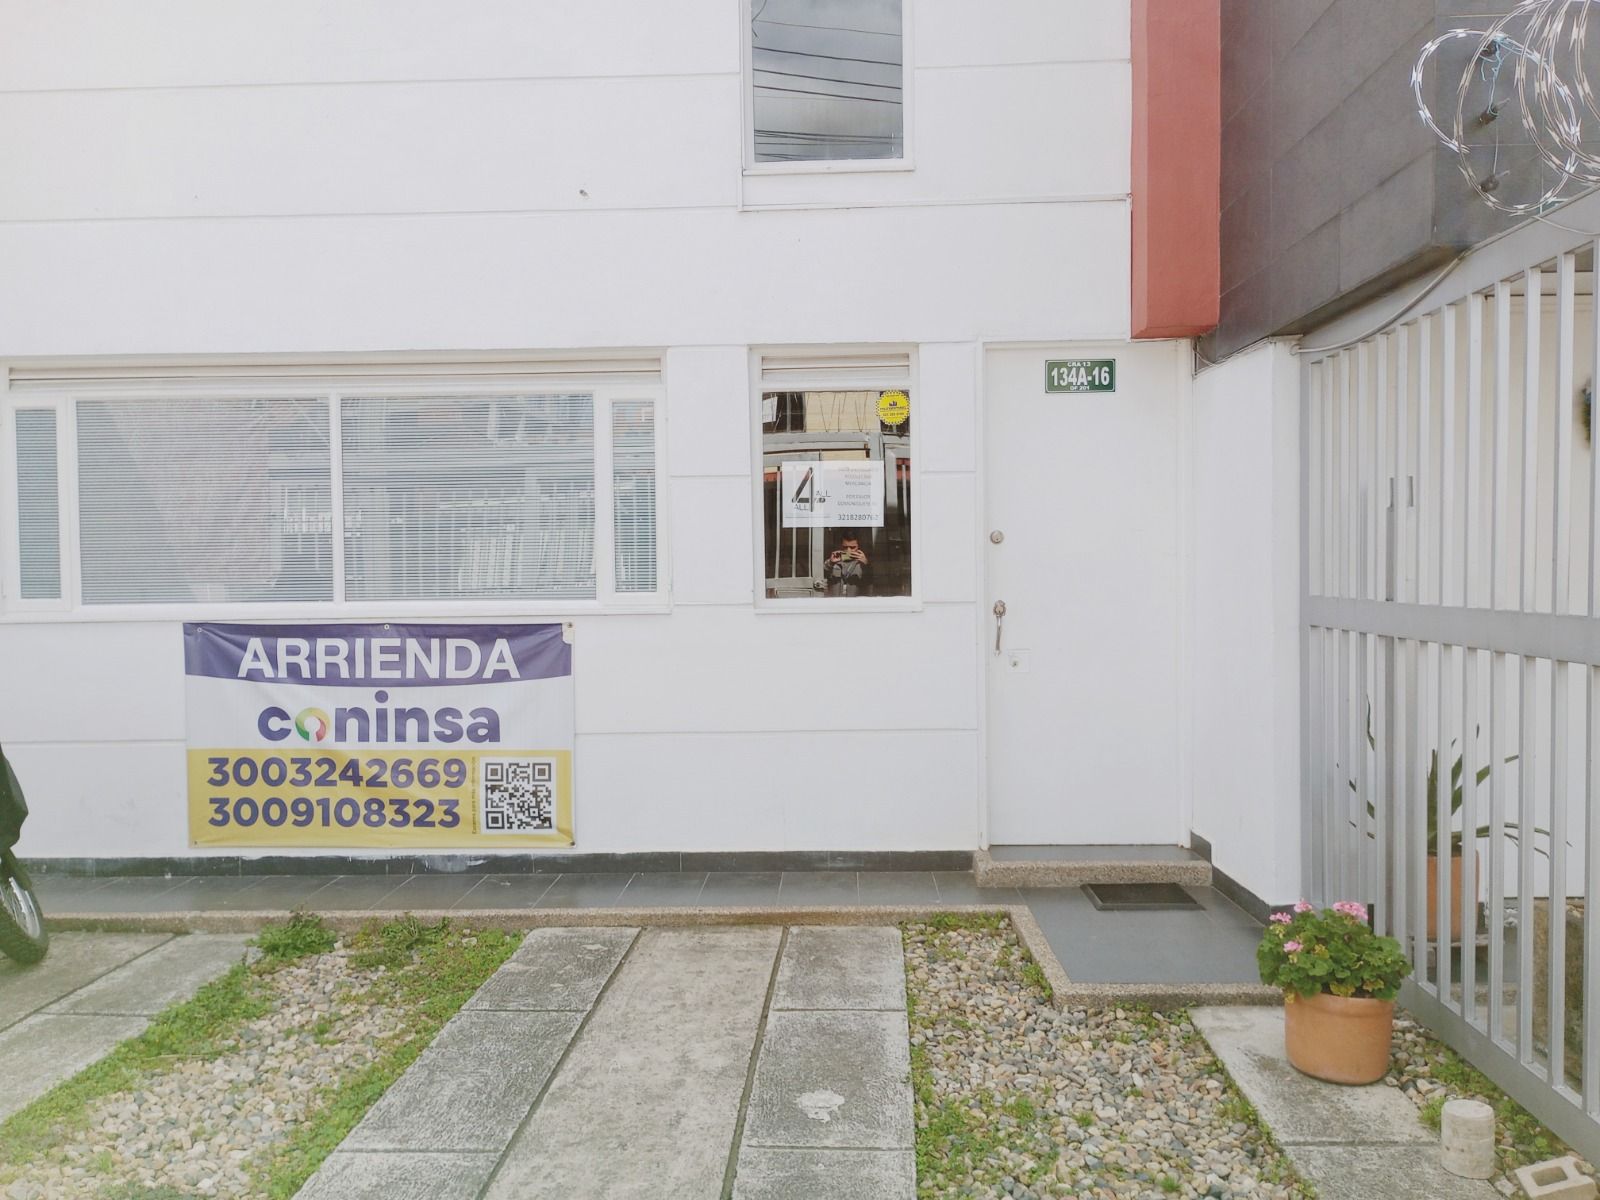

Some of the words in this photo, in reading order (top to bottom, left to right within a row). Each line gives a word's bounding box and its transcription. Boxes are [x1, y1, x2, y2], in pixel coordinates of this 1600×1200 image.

[1051, 366, 1110, 386] 134A-16
[236, 637, 521, 680] ARRIENDA
[257, 690, 501, 744] coninsa
[206, 756, 467, 789] 3003242669
[207, 796, 461, 829] 3009108323
